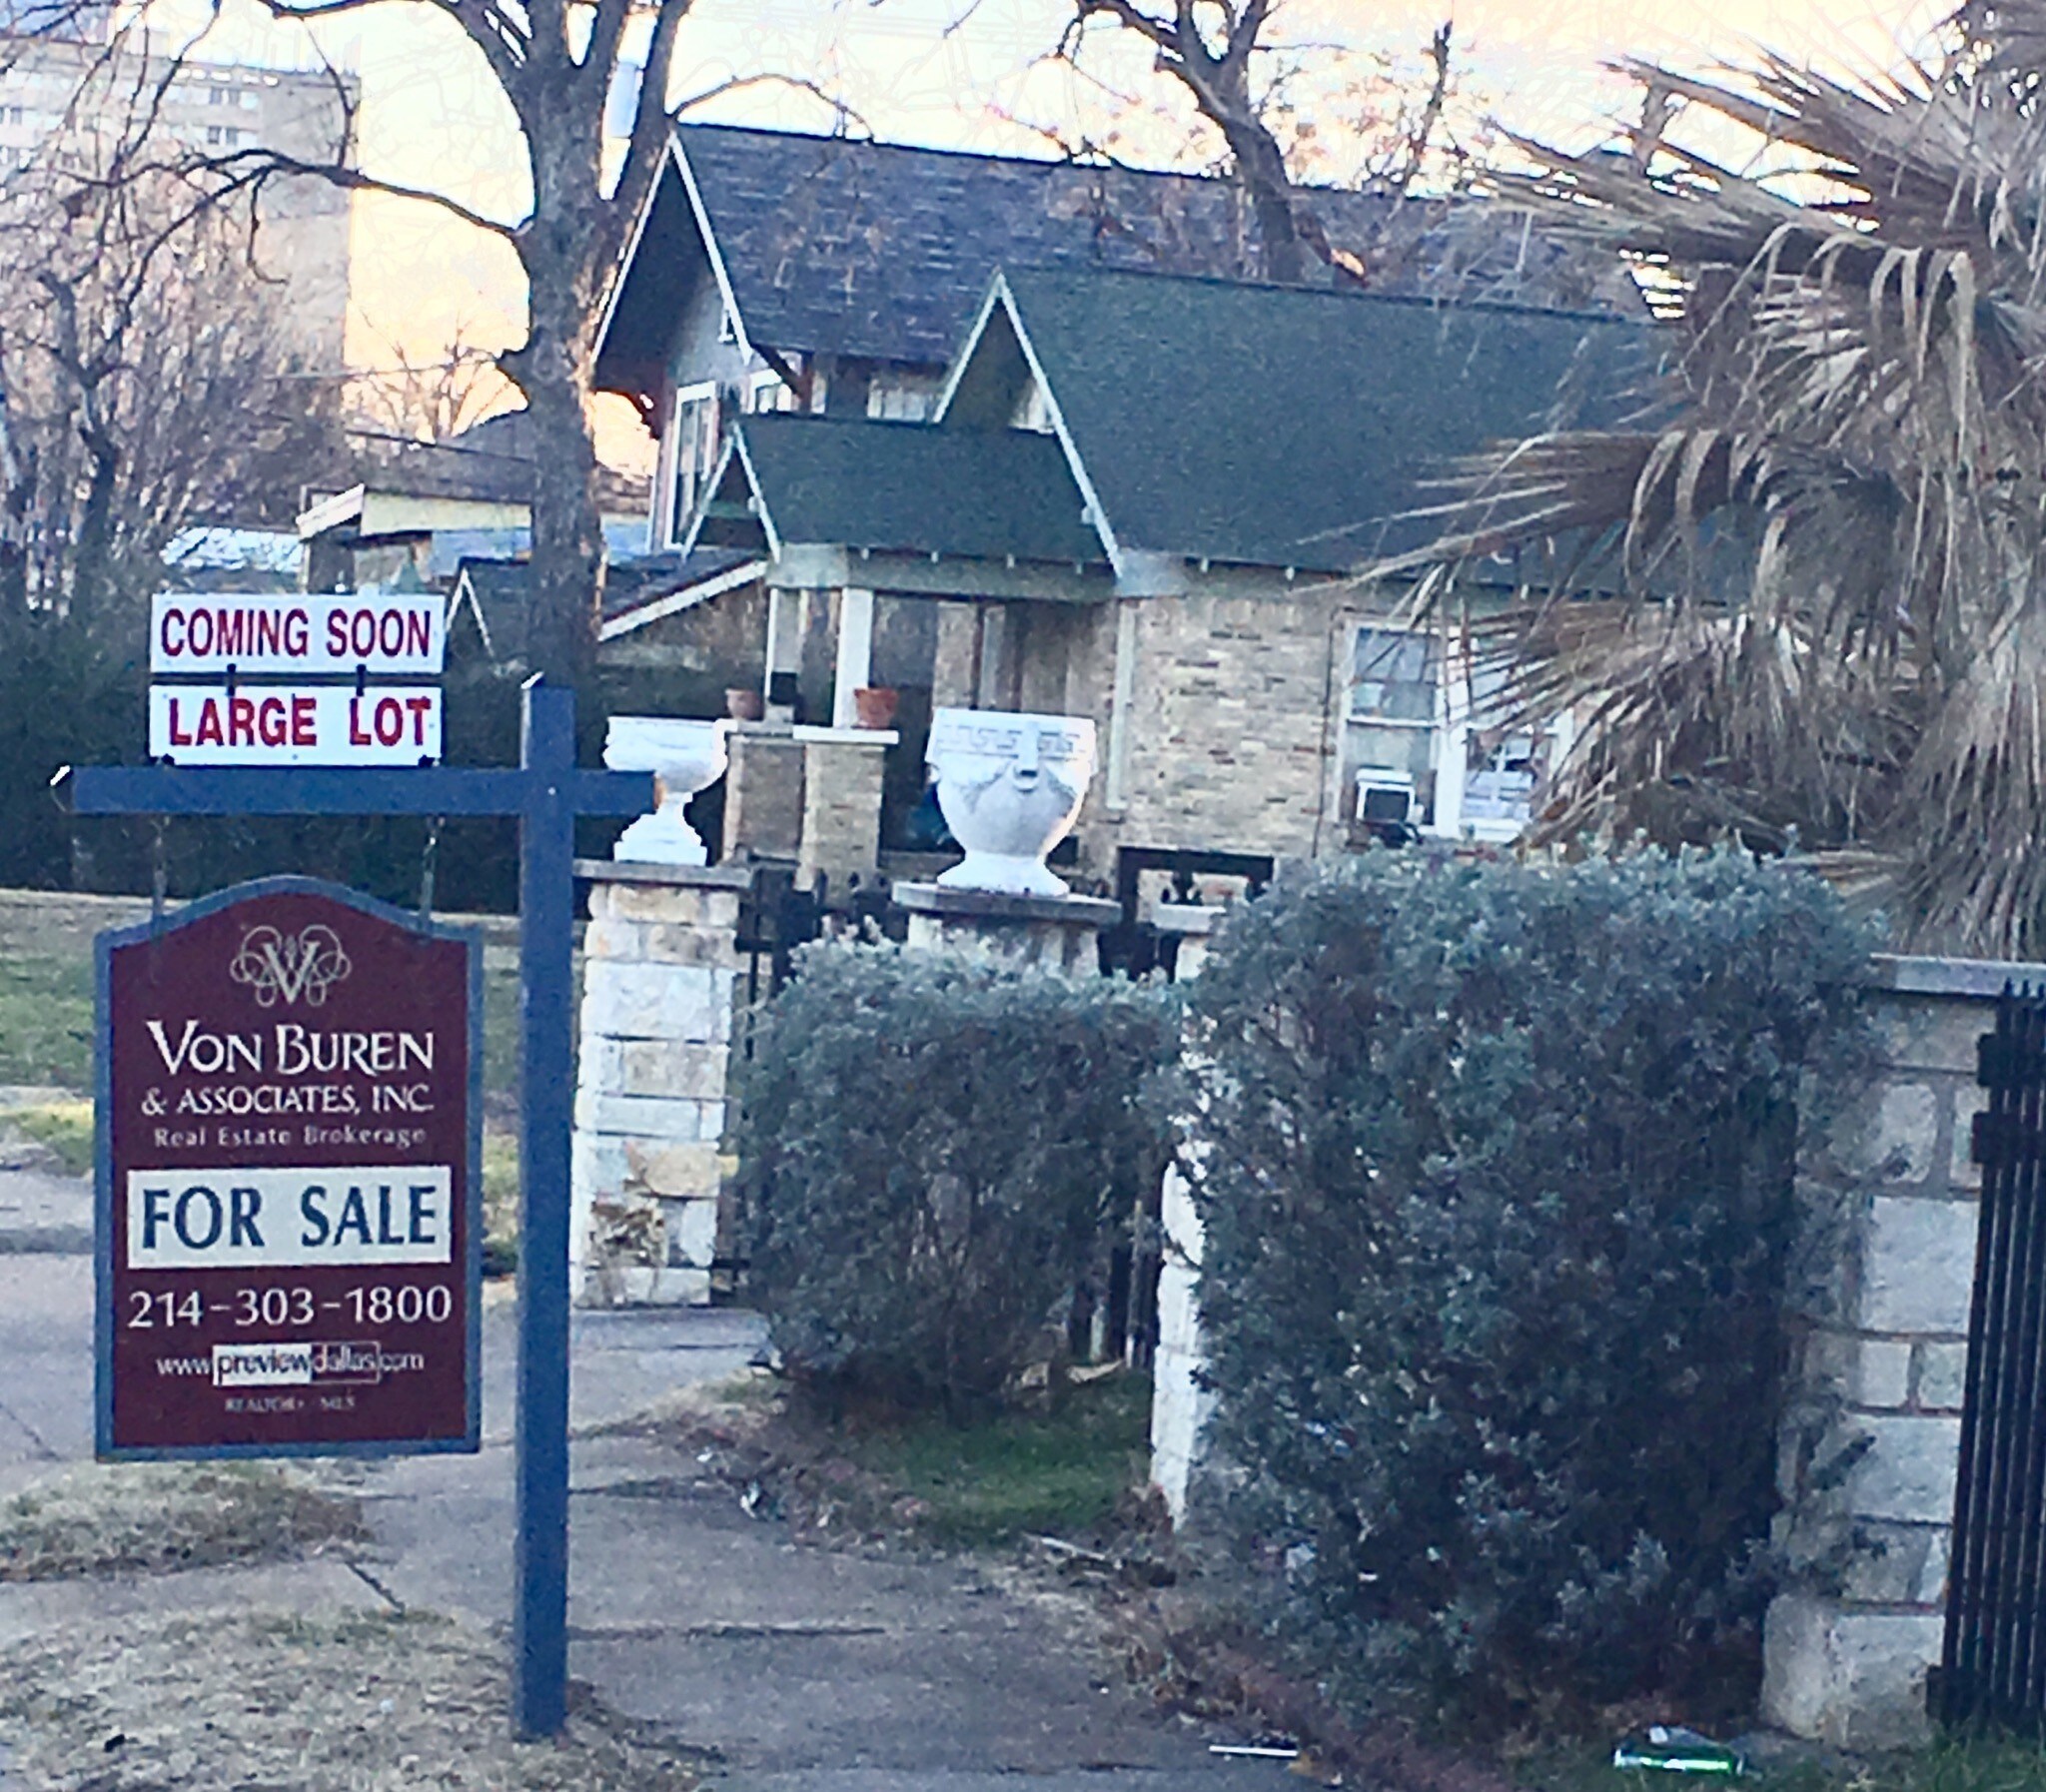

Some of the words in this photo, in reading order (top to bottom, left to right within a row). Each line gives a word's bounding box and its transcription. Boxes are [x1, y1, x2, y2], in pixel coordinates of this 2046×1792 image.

[161, 608, 309, 657] COMING
[326, 608, 431, 657] SOON
[168, 694, 317, 747] LARGE
[349, 697, 432, 746] LOT
[141, 1087, 168, 1116] &
[176, 1085, 361, 1116] ASSOCIATES,
[154, 1128, 206, 1148] Real
[218, 1127, 291, 1147] Estate
[304, 1125, 428, 1150] Brokerage
[142, 1186, 265, 1249] FOR
[300, 1185, 437, 1248] SALE
[127, 1285, 452, 1328] 214-303-1800
